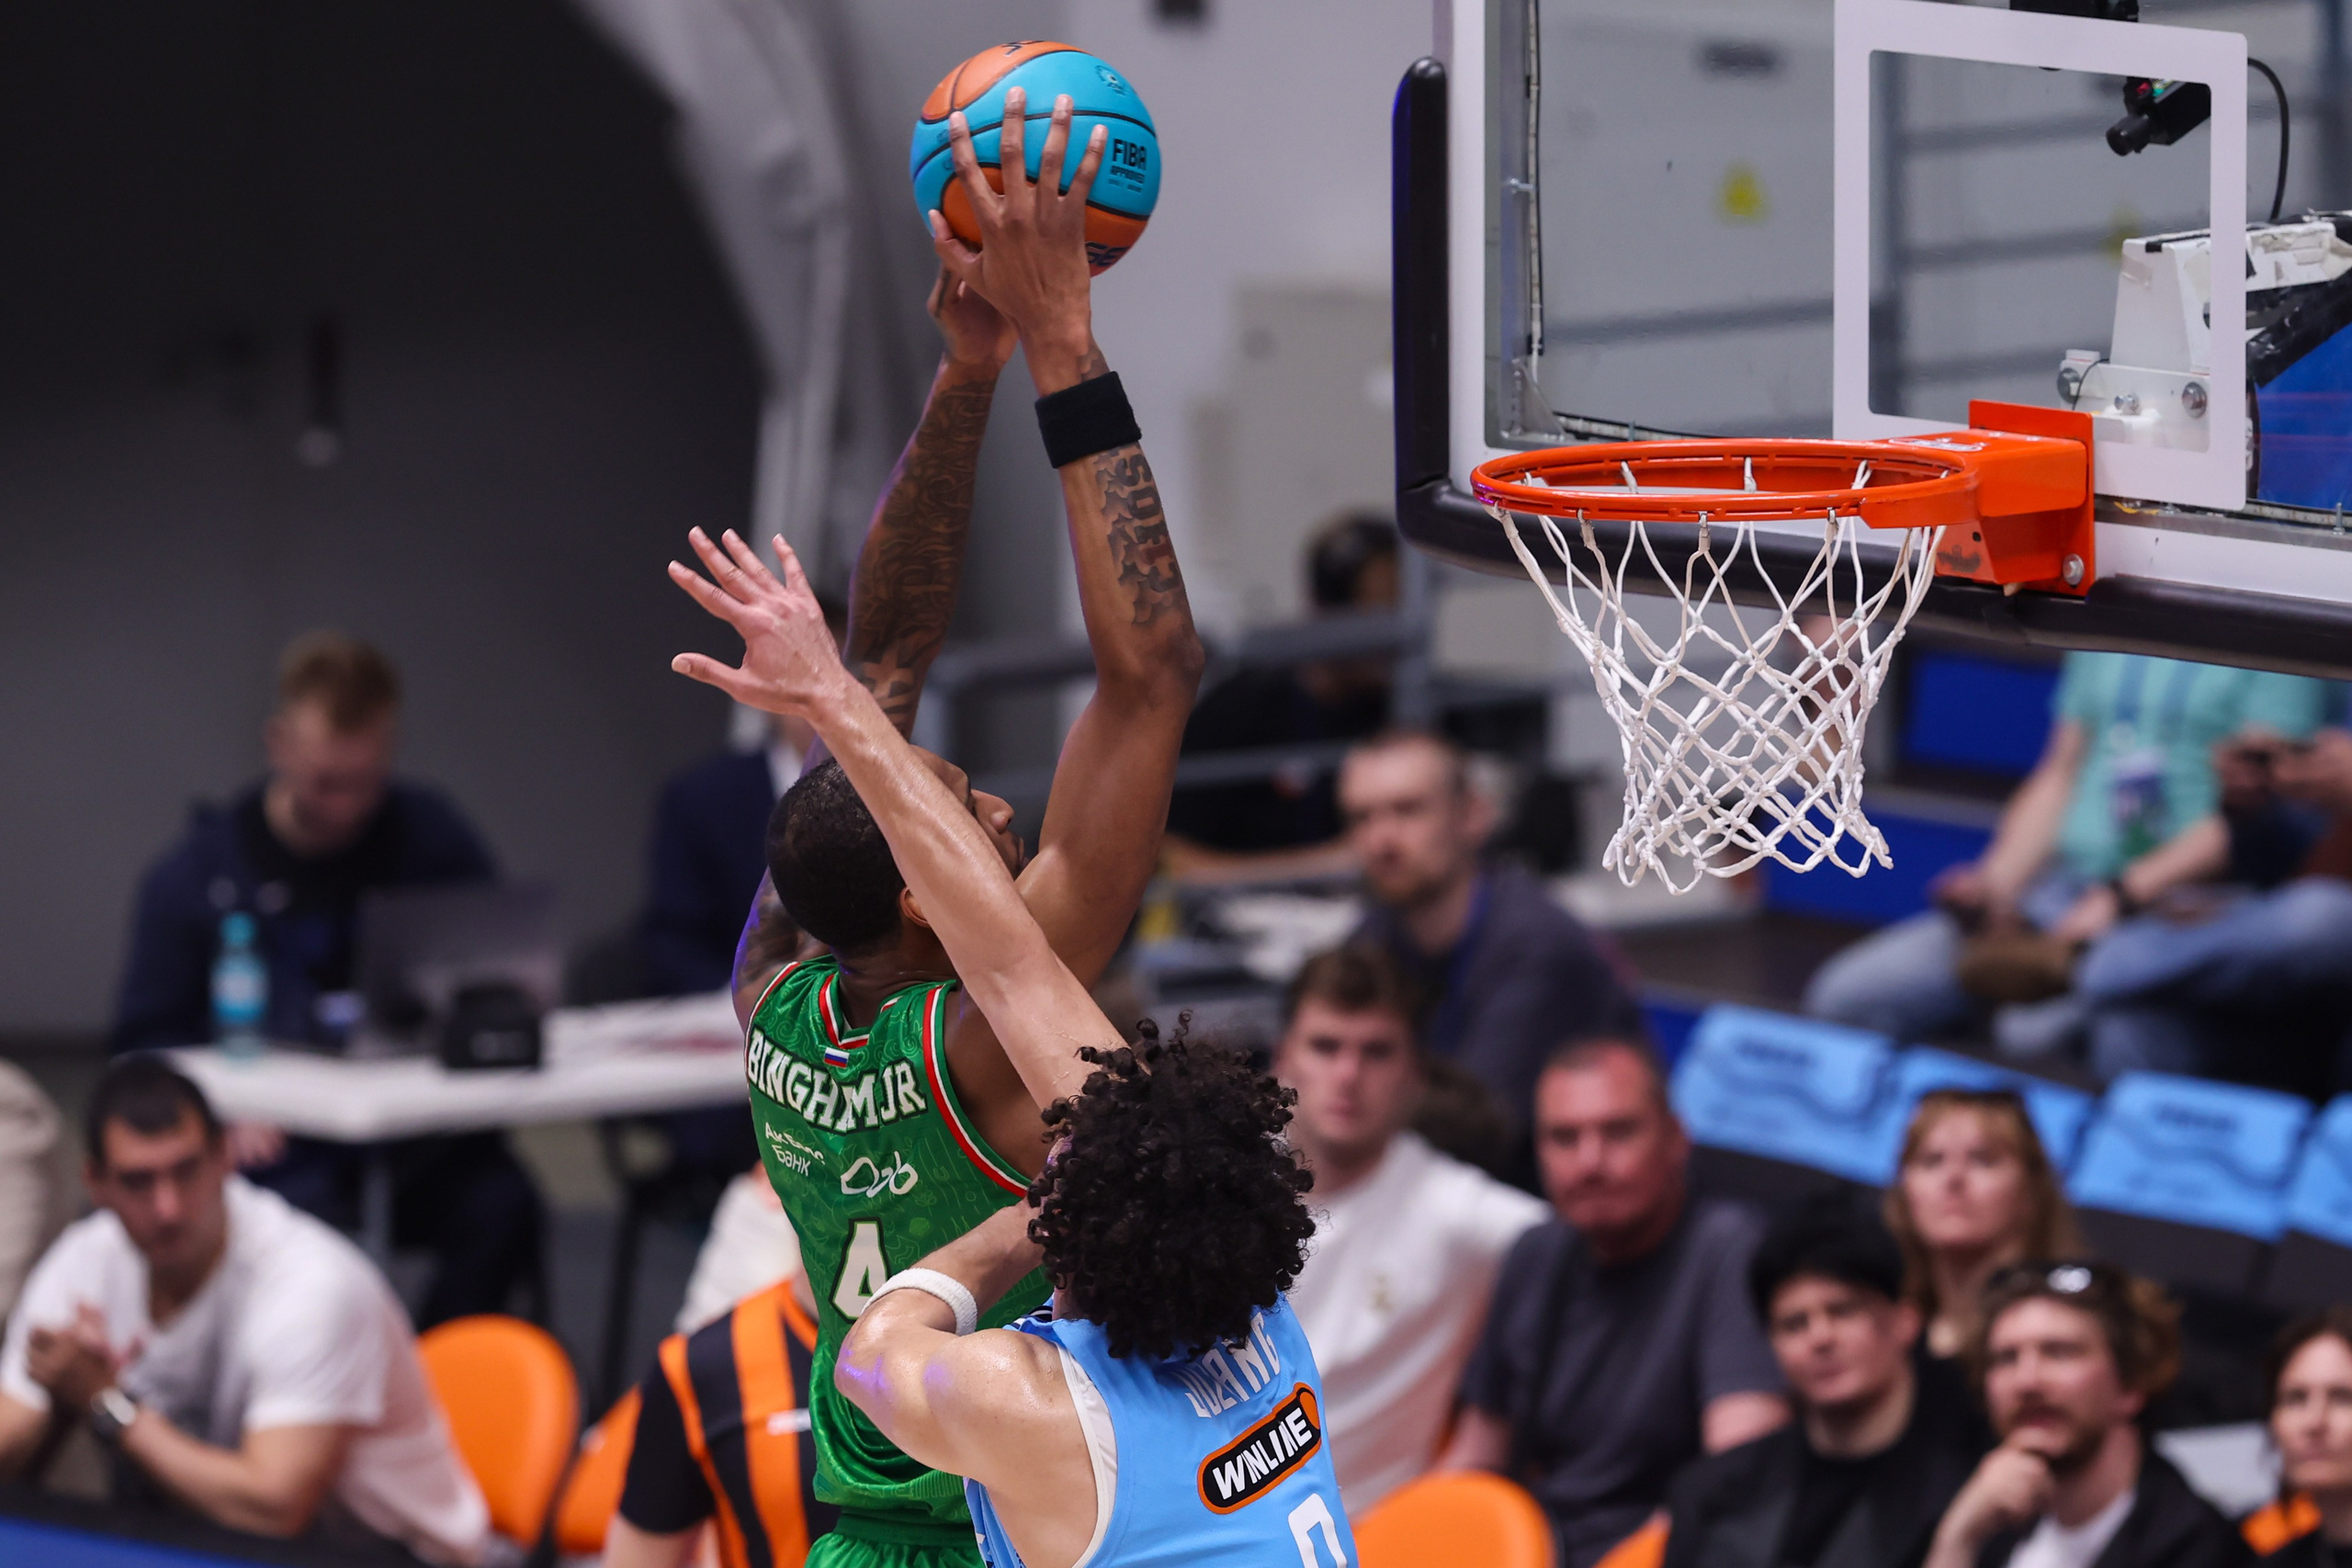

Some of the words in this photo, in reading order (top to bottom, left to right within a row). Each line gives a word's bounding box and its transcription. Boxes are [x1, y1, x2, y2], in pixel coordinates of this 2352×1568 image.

[1112, 139, 1147, 171] FIBA
[880, 1062, 927, 1122] JR
[772, 1144, 811, 1177] Банк
[831, 1220, 888, 1321] 4
